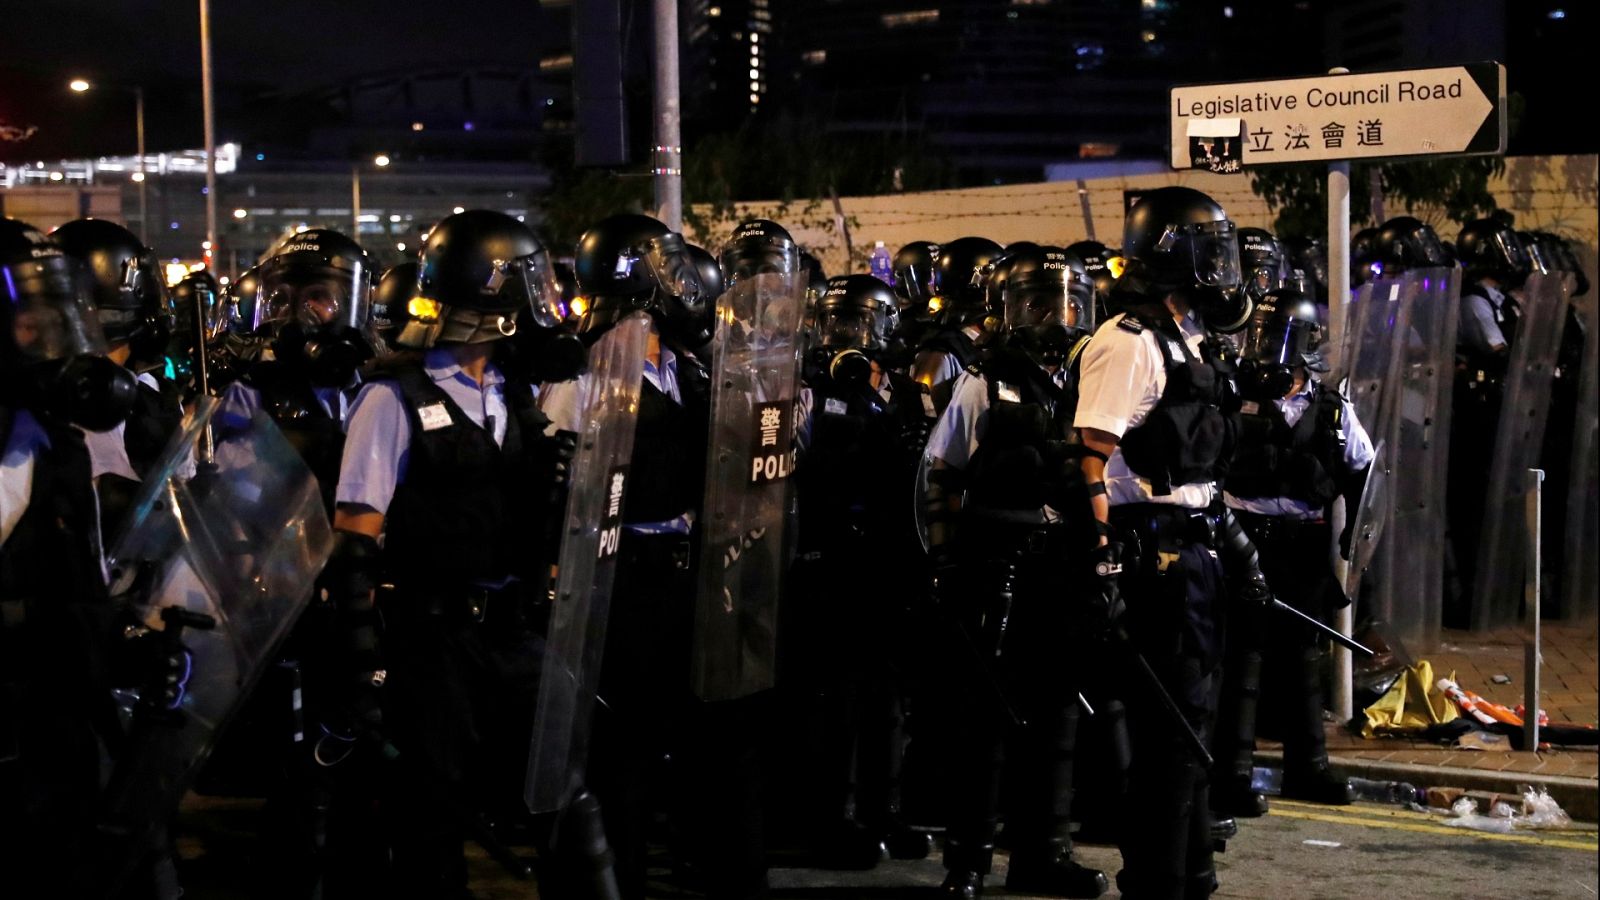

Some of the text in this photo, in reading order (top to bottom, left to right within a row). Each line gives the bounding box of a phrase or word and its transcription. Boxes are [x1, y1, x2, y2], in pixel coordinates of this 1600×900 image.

[1177, 79, 1462, 118] Legislative Council Road
[1249, 118, 1384, 153] 立法會道
[1043, 262, 1070, 270] Police
